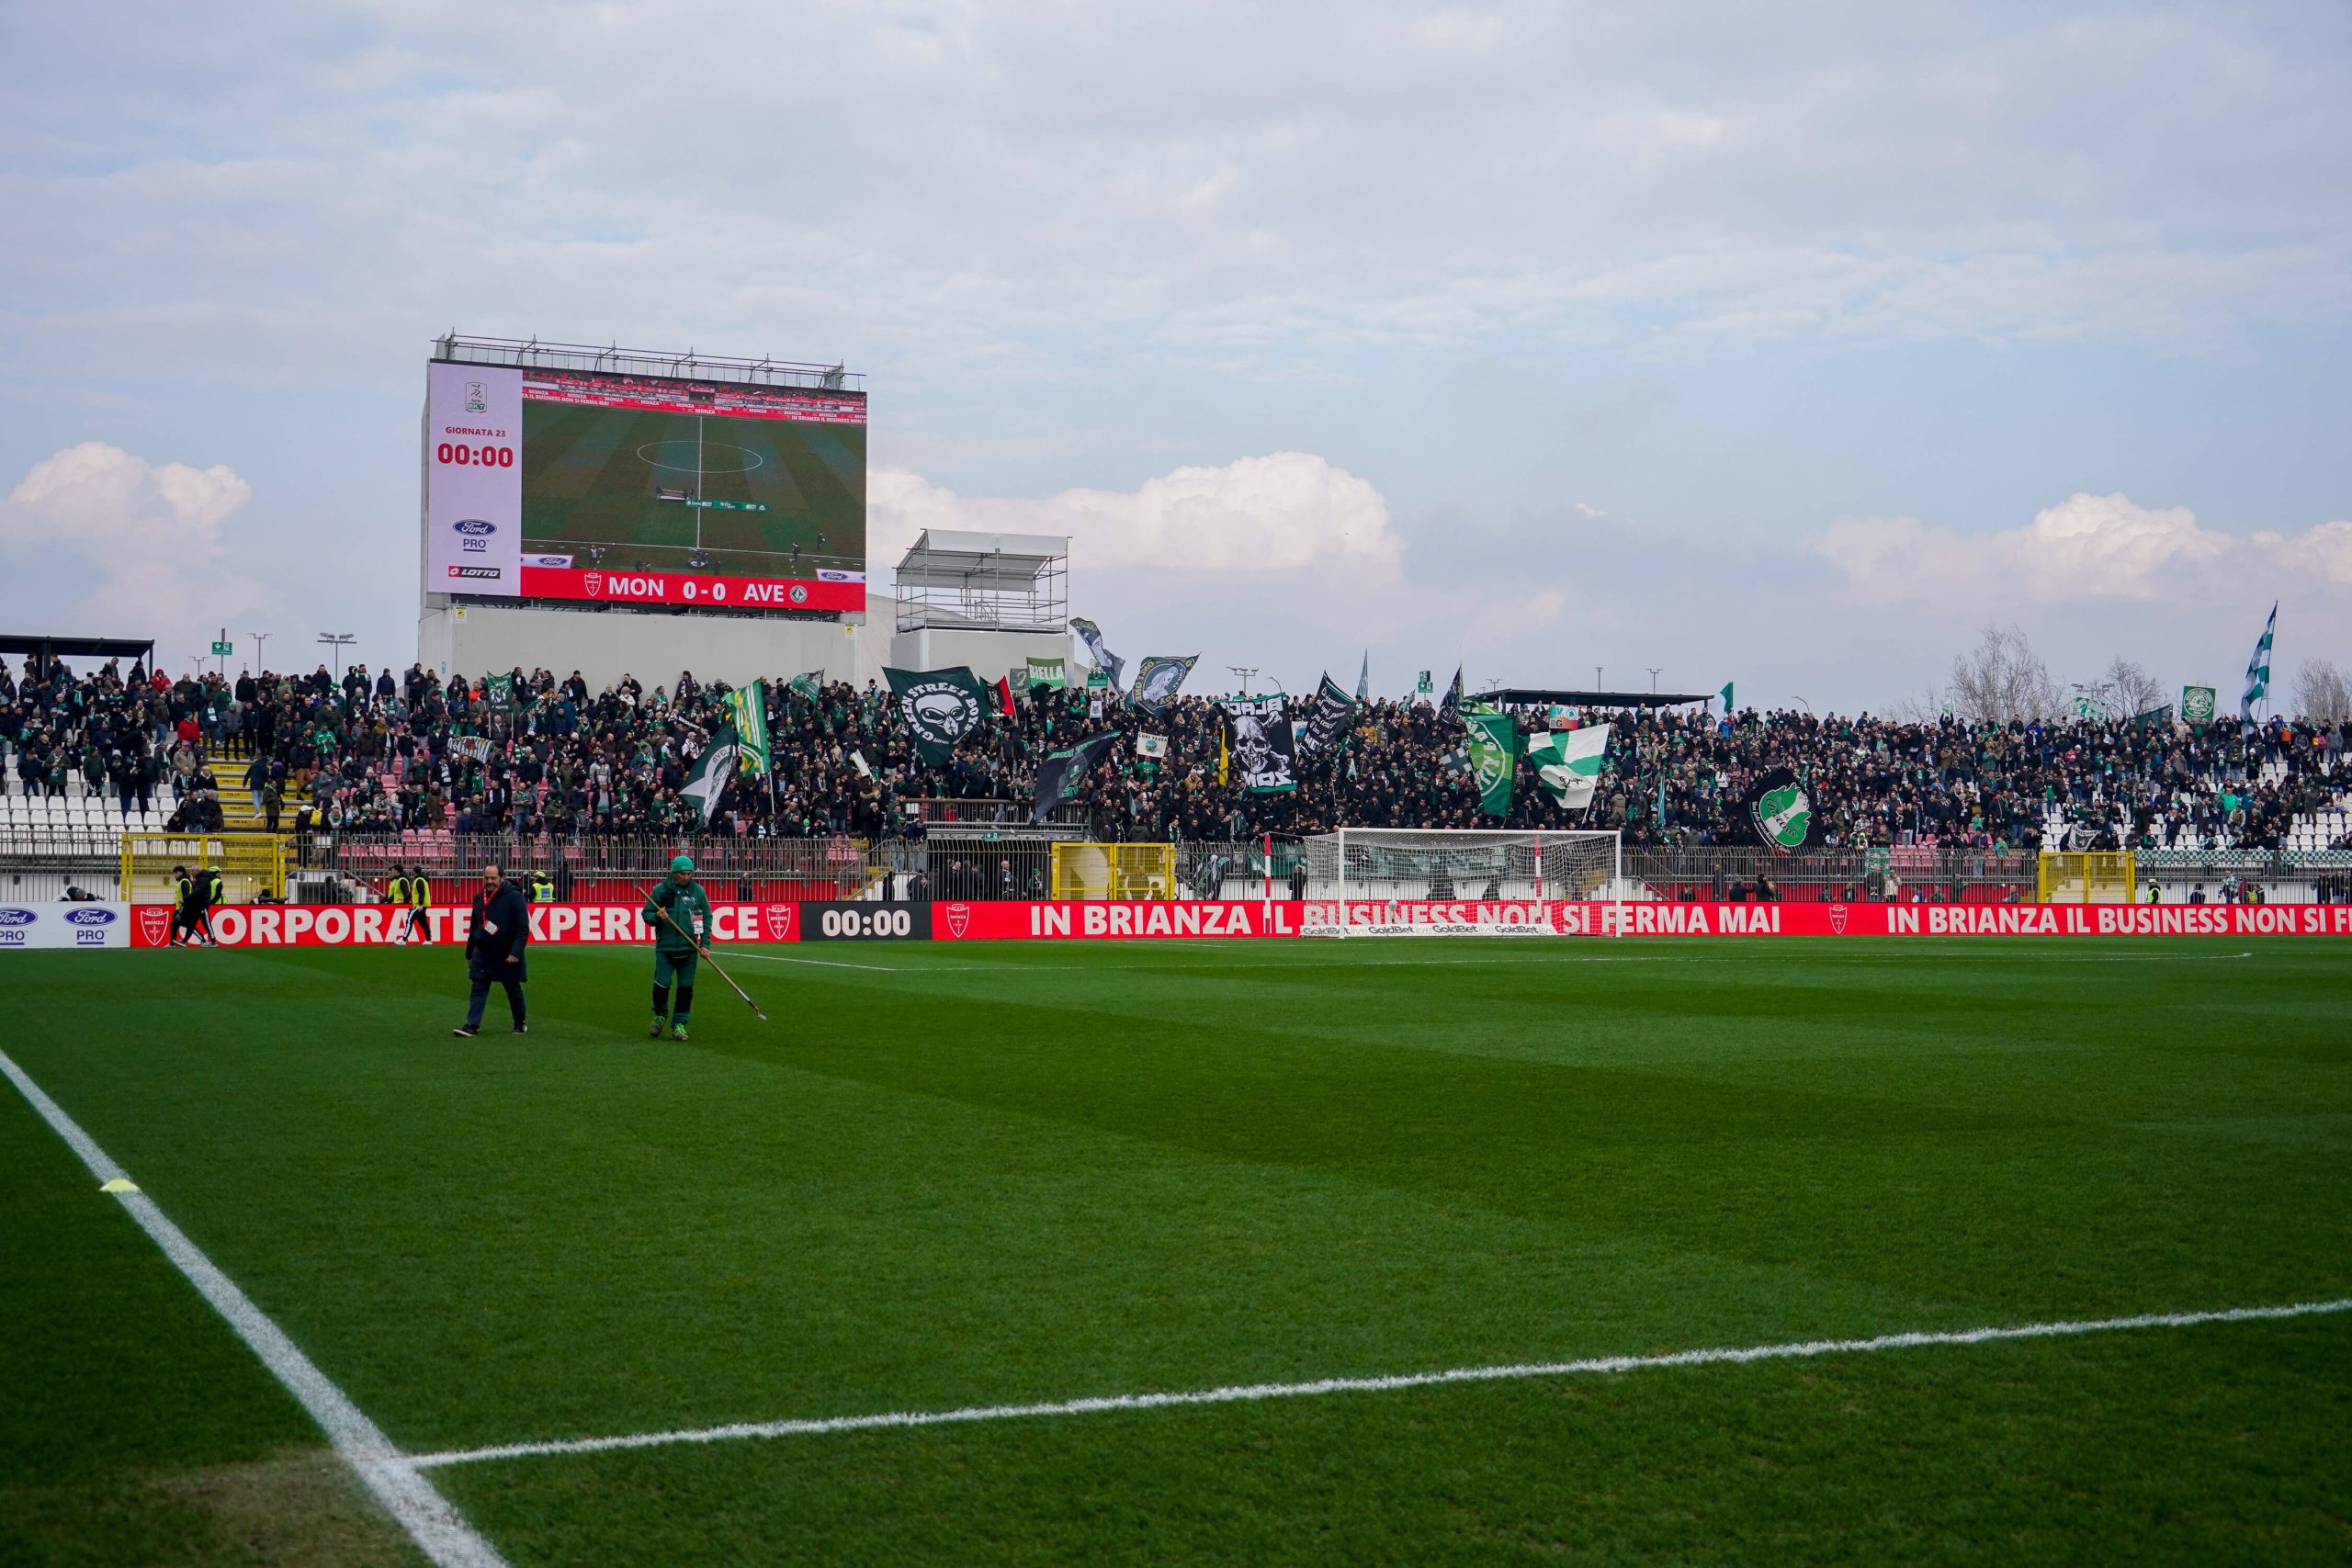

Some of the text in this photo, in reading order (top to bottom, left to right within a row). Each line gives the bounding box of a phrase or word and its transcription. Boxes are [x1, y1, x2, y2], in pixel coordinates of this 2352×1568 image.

[446, 426, 493, 436] GIORNATA
[438, 443, 513, 468] 00:00
[461, 522, 488, 533] Ford
[463, 538, 486, 548] PRO
[461, 569, 499, 577] LOTTO
[608, 577, 664, 597] MON
[743, 583, 785, 602] AVE
[1028, 663, 1065, 680] BIELLA
[900, 682, 979, 741] GREEN STREET BOYS
[74, 909, 107, 923] Ford
[527, 906, 760, 942] XPERICE
[822, 909, 910, 937] 00:00
[1031, 904, 1781, 936] IN BRIANZA IL BUSINESS NON SI FERMA MAI
[1887, 907, 1919, 933] IN
[1928, 907, 2059, 933] BRIANZA
[2066, 907, 2091, 933] IL
[2098, 907, 2229, 934] BUSINESS
[2235, 907, 2297, 933] NON
[2303, 907, 2327, 933] SI
[76, 930, 105, 940] PRO
